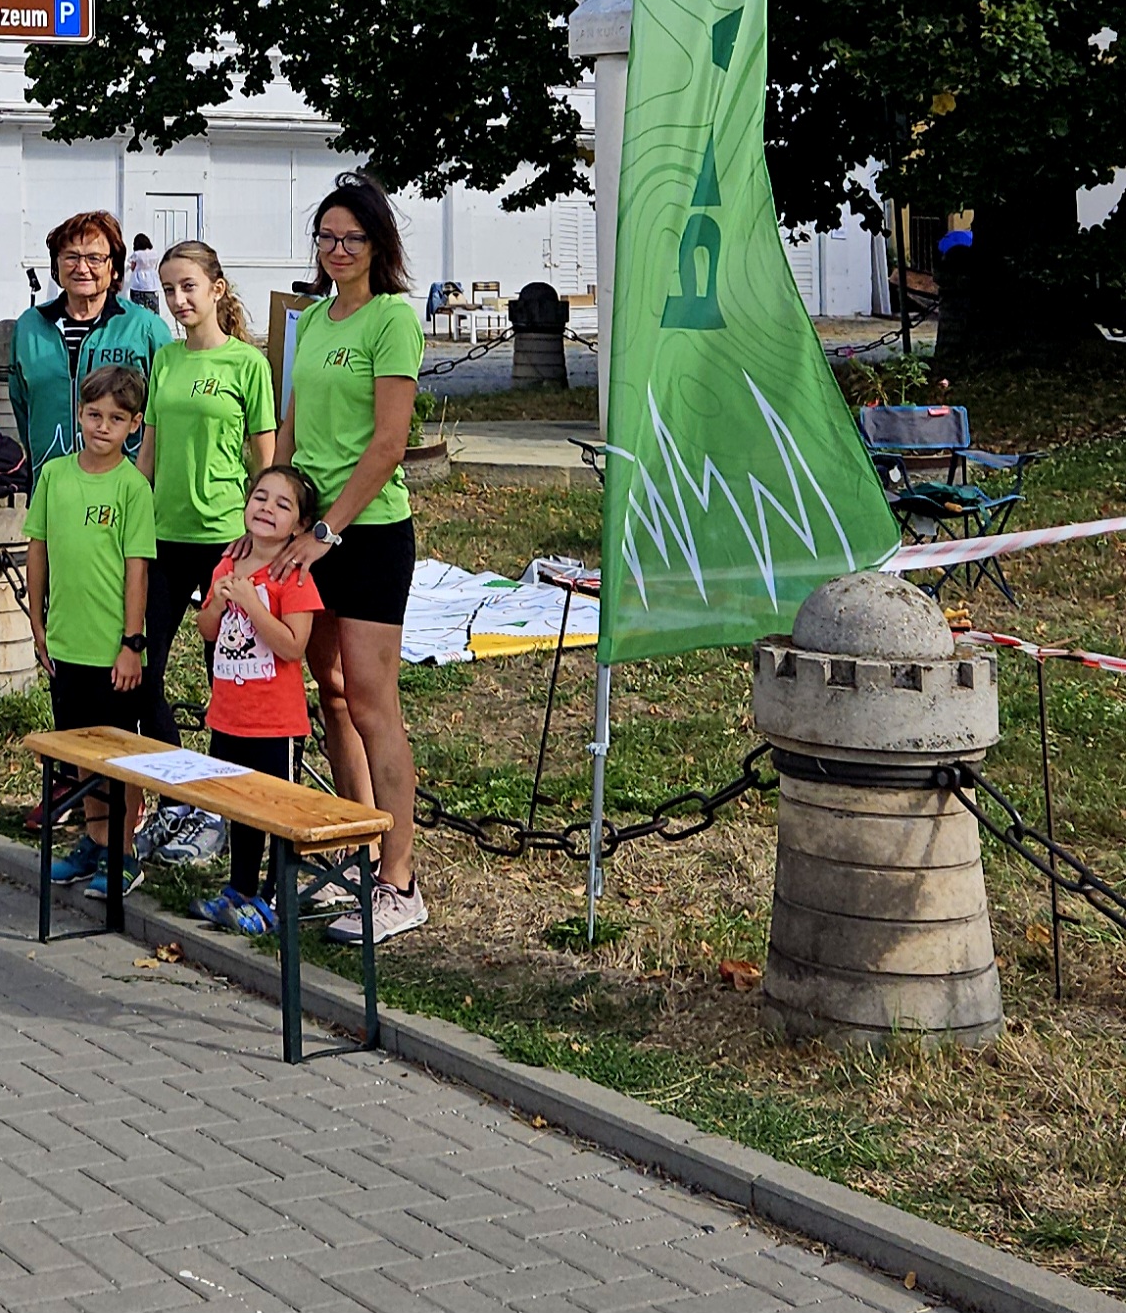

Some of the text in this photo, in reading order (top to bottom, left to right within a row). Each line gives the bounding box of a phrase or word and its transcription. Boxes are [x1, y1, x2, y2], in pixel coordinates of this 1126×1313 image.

[60, 2, 75, 25] P
[100, 348, 136, 366] RBK
[322, 346, 358, 373] RBK
[190, 377, 227, 400] RBK
[84, 504, 121, 529] RBK
